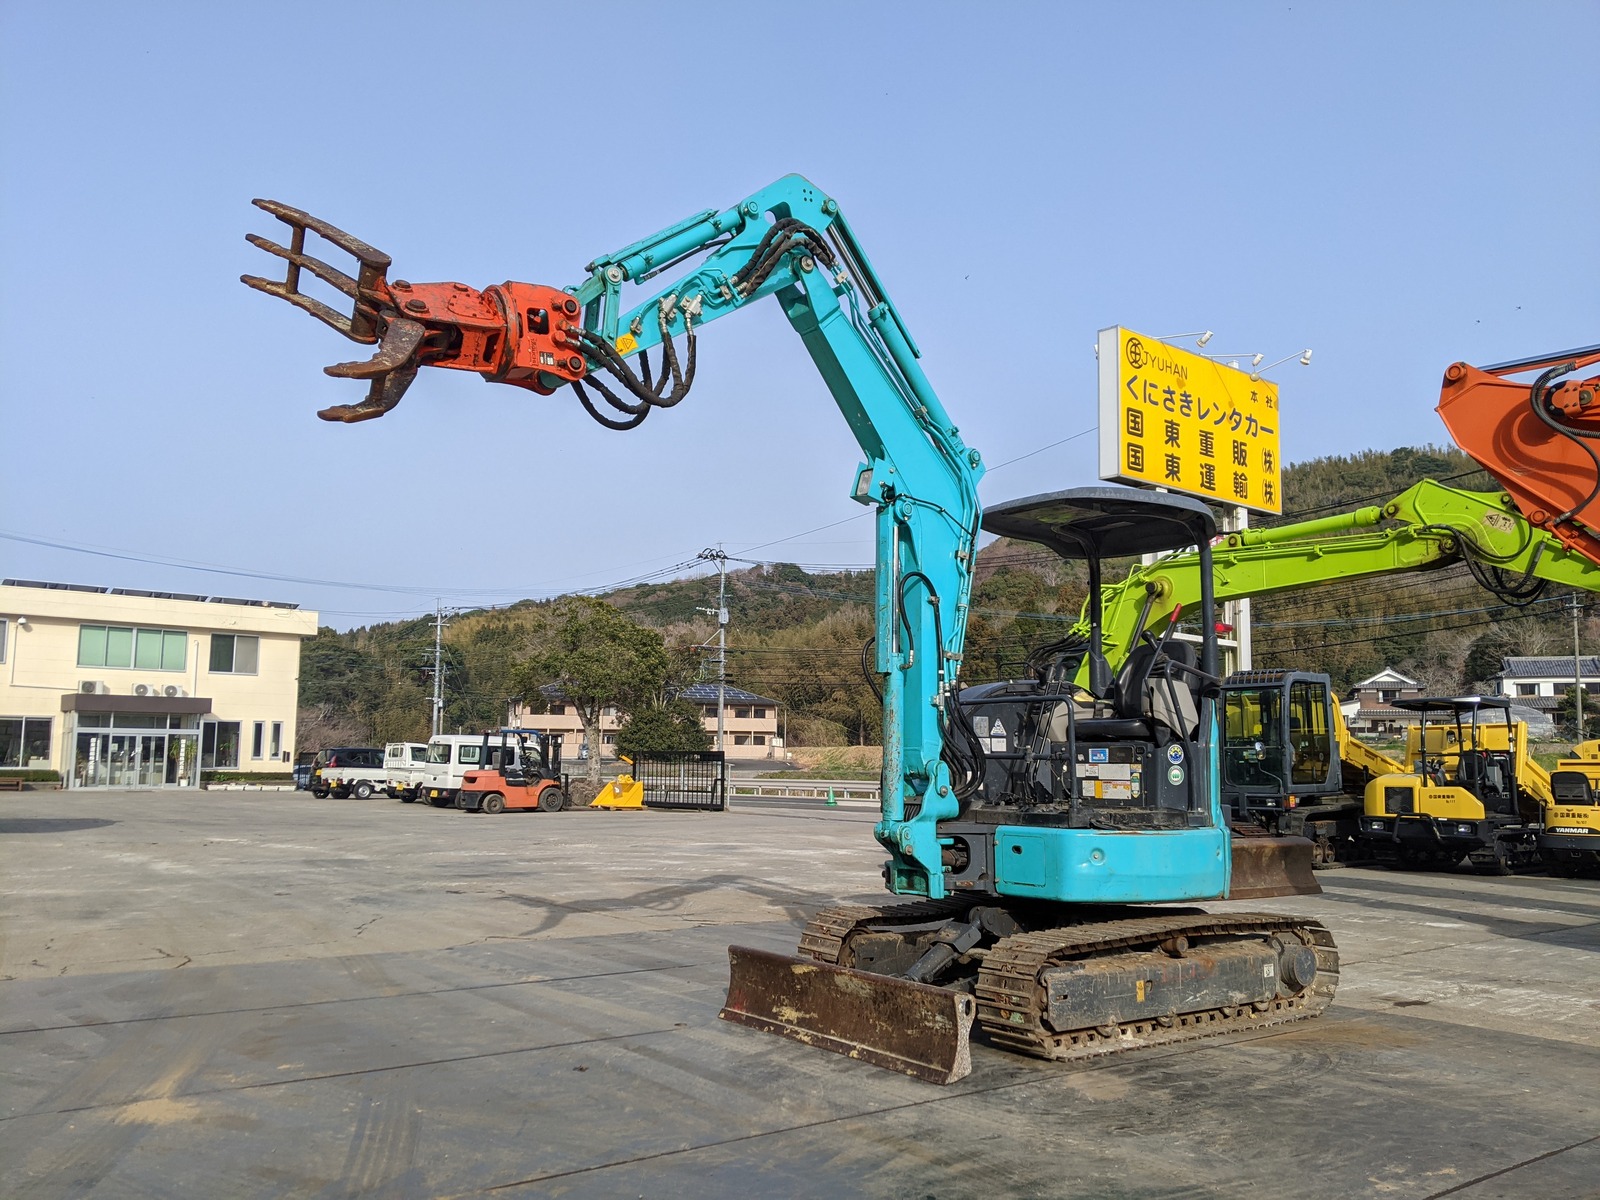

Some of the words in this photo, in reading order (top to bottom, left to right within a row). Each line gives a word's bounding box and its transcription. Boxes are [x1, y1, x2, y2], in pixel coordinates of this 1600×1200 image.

[1141, 350, 1188, 380] JYUHAN
[1126, 374, 1275, 438] くにさきレンタカー
[1250, 390, 1273, 409] 本社
